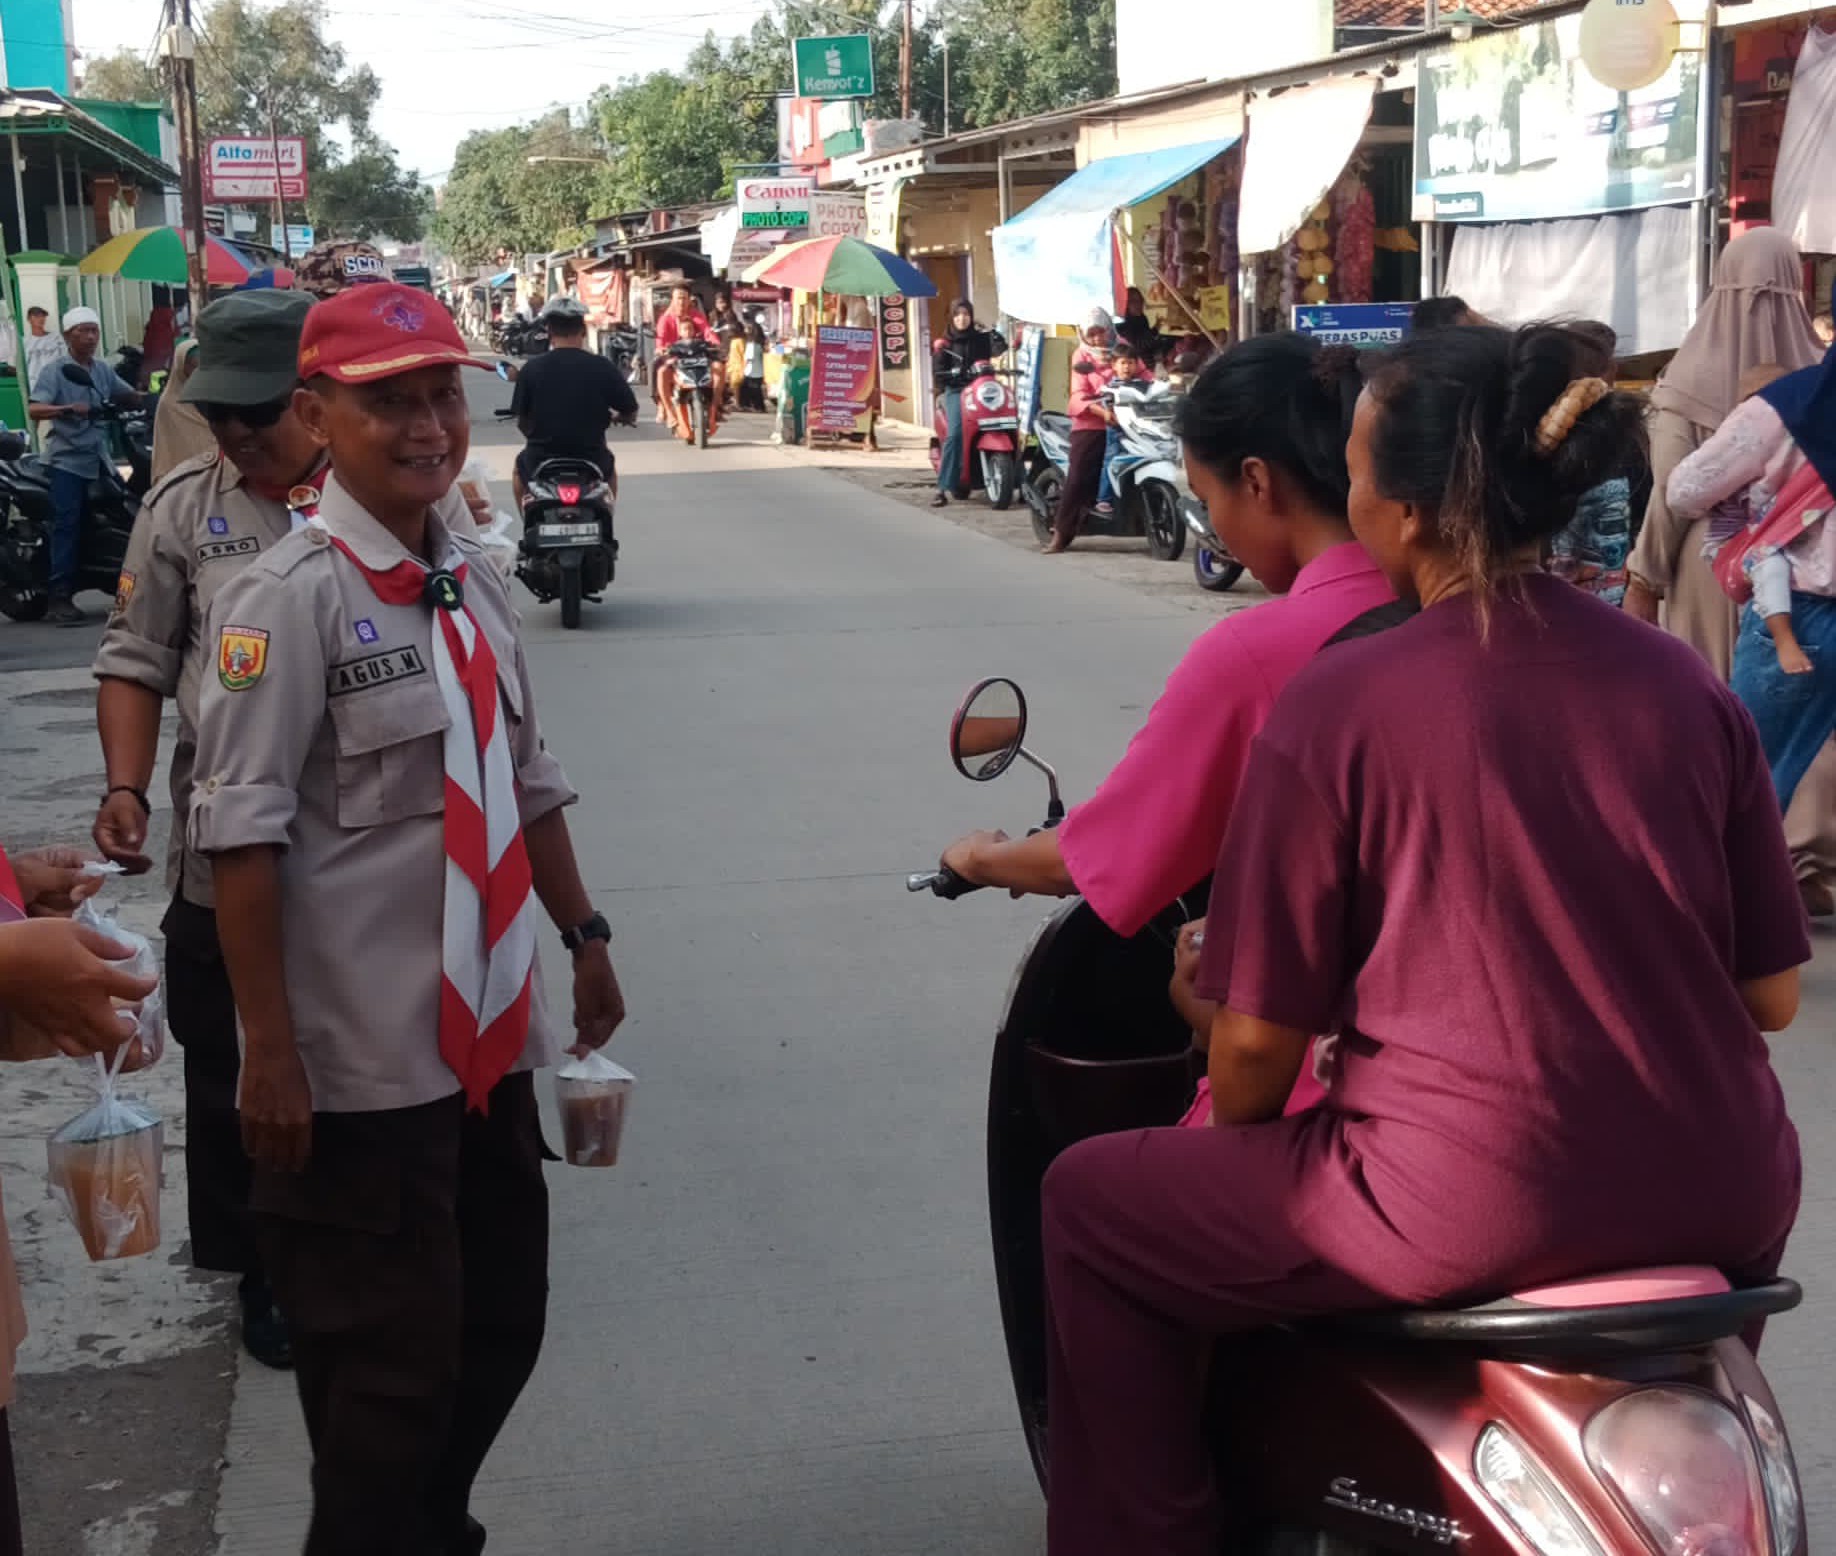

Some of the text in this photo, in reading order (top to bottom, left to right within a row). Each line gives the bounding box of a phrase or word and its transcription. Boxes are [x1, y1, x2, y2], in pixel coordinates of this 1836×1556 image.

[744, 184, 808, 199] Canon
[743, 212, 779, 227] PHOTO
[820, 221, 861, 237] COPY
[1324, 1477, 1472, 1544] Scoopy
